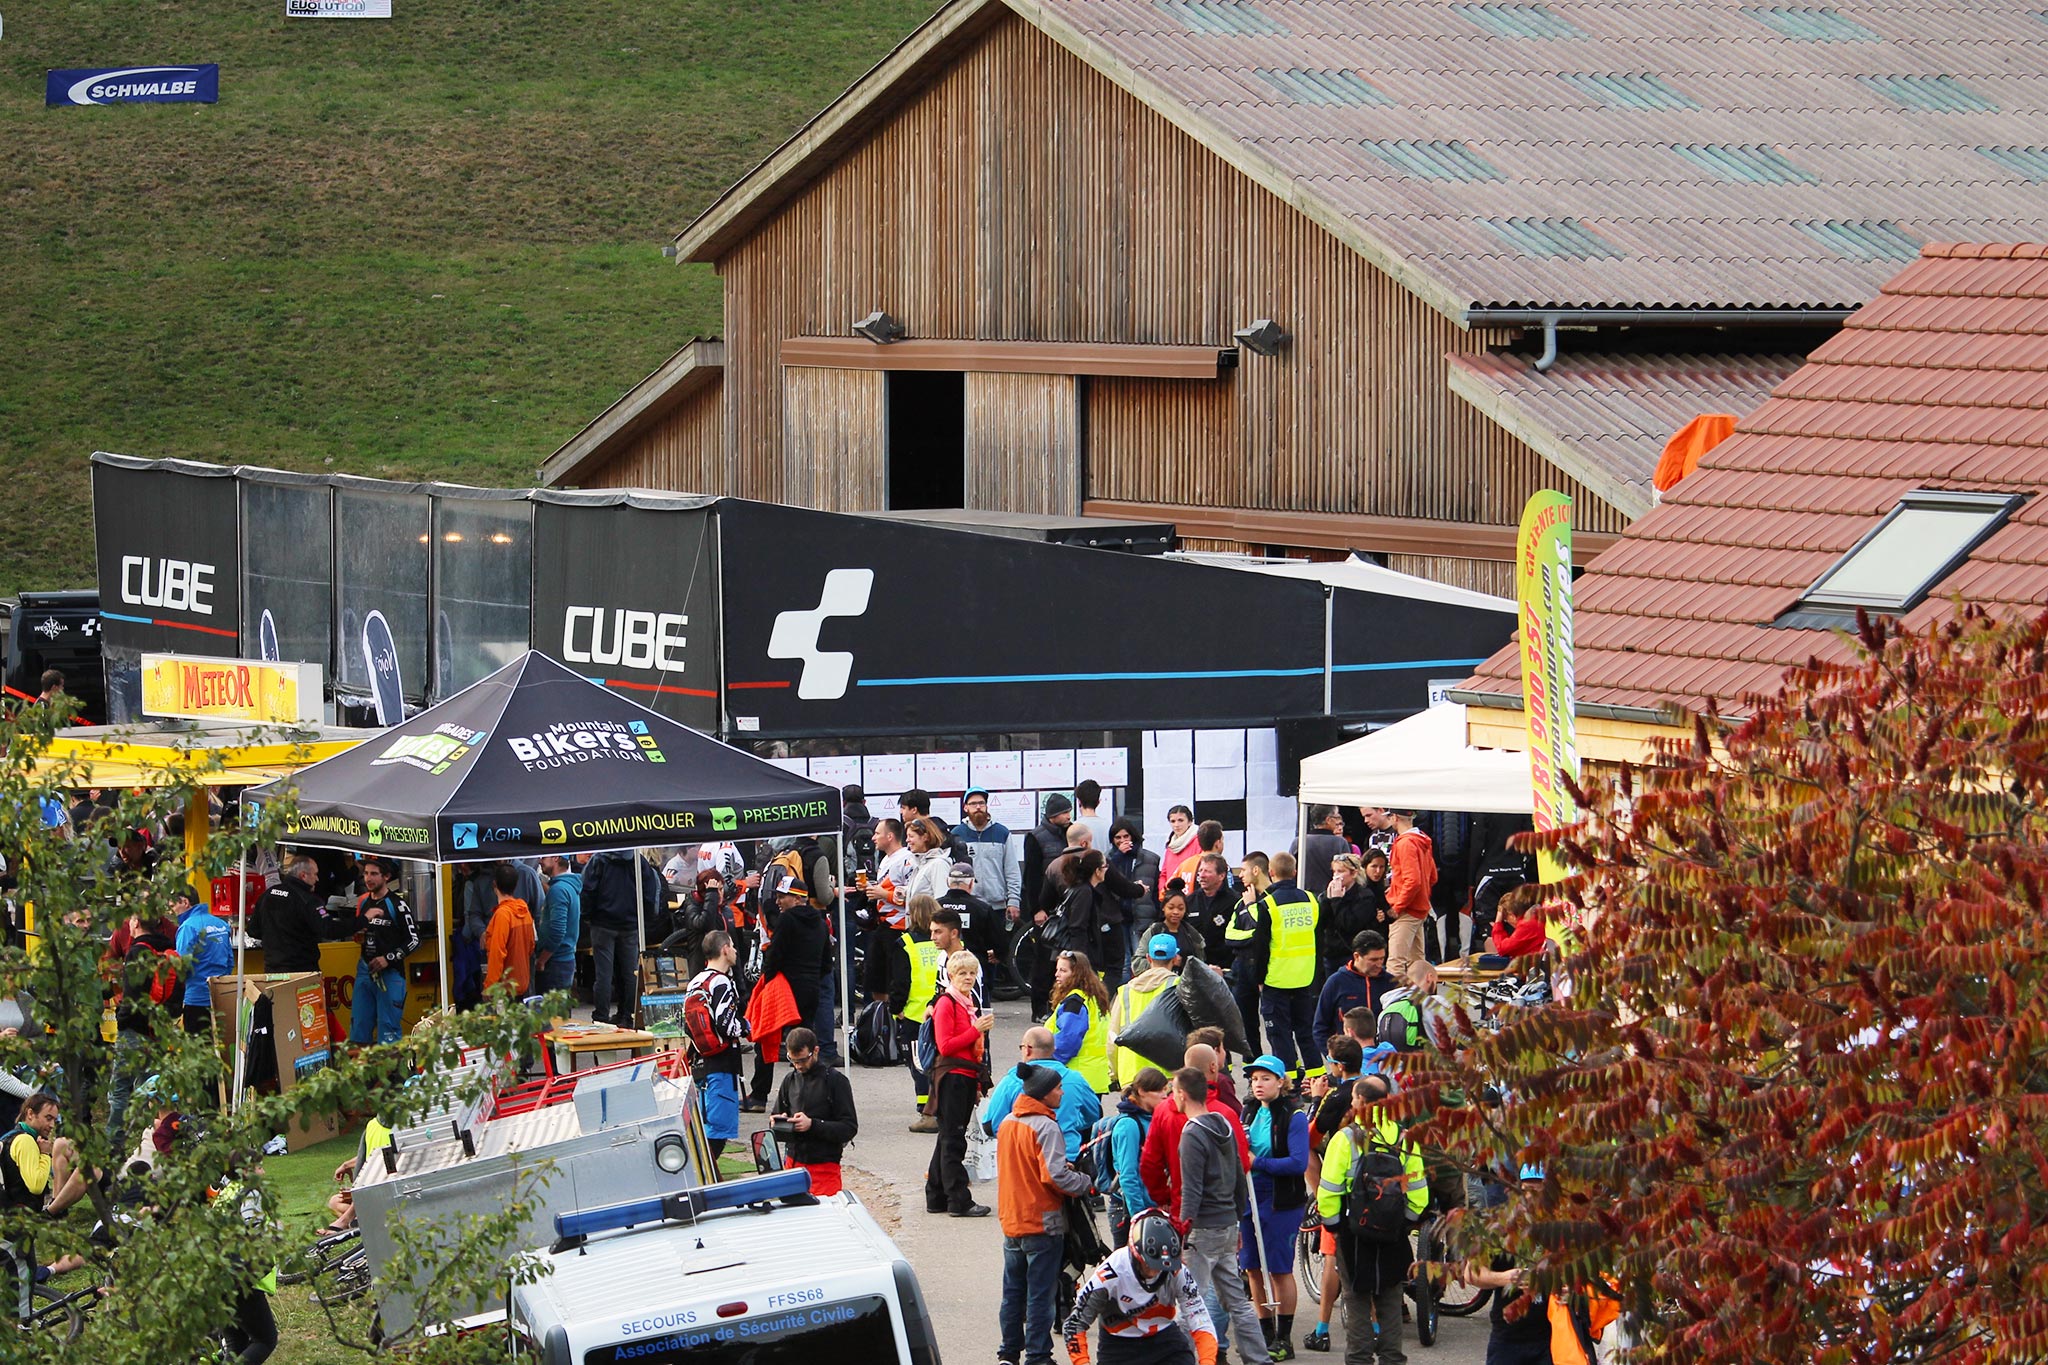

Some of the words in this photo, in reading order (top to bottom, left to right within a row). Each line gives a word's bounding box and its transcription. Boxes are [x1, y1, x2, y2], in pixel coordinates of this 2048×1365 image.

[91, 81, 197, 98] SCHWALBE
[121, 555, 215, 615] CUBE
[563, 605, 689, 673] CUBE
[1525, 600, 1544, 674] 357
[183, 665, 254, 709] METEOR
[1529, 671, 1548, 745] 900
[550, 720, 627, 735] Mountain
[507, 731, 637, 762] Bikers
[523, 749, 645, 772] FOUNDATION
[1531, 746, 1551, 791] 81
[742, 800, 828, 824] PRESERVER
[300, 815, 361, 836] COMMUNIQUER
[383, 825, 430, 844] PRESERVER
[482, 828, 521, 842] AGIR
[572, 812, 695, 839] COMMUNIQUER
[1282, 907, 1311, 918] SECOURS
[1284, 916, 1313, 928] FFSS
[768, 1287, 824, 1309] FFSS68
[614, 1330, 711, 1361] Association
[716, 1323, 735, 1341] de
[739, 1312, 806, 1337] Sécurité
[810, 1305, 855, 1325] Civile
[621, 1310, 697, 1335] SECOURS
